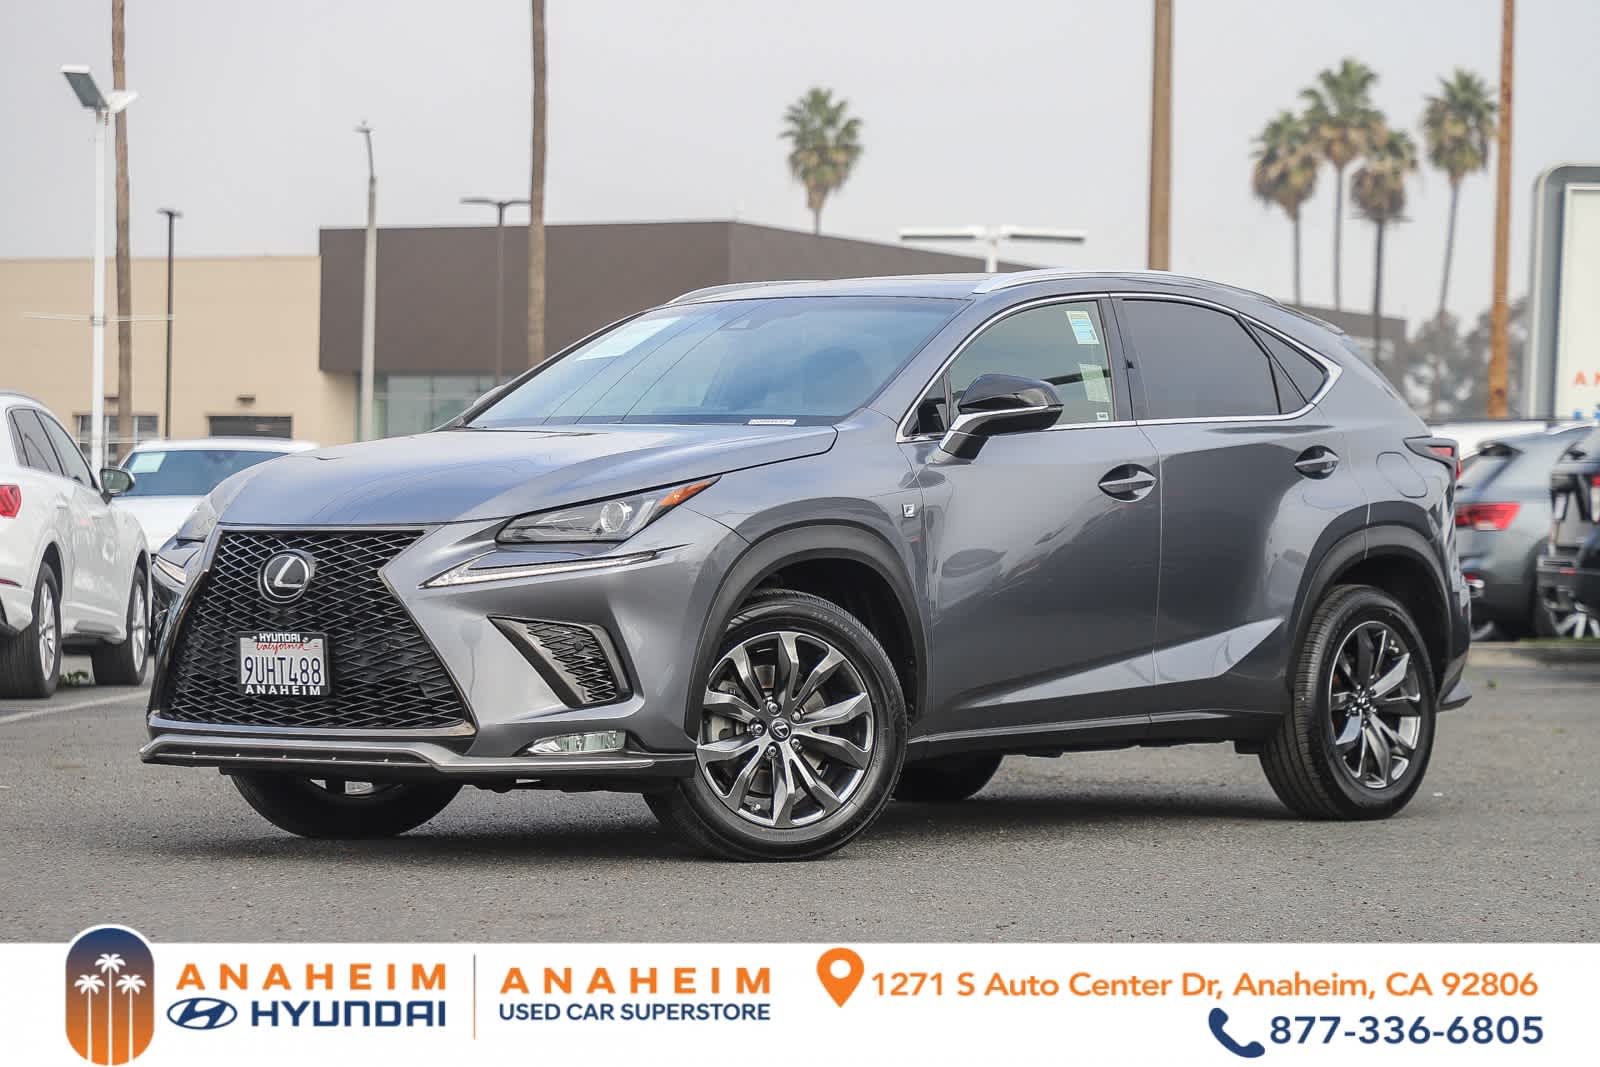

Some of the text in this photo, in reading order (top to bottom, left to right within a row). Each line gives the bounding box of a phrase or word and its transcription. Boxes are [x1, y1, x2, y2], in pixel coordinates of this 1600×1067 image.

[259, 633, 301, 642] HYUNDAI
[255, 642, 305, 654] California
[244, 656, 321, 685] 9UHT488
[244, 684, 321, 696] ANAHEIM
